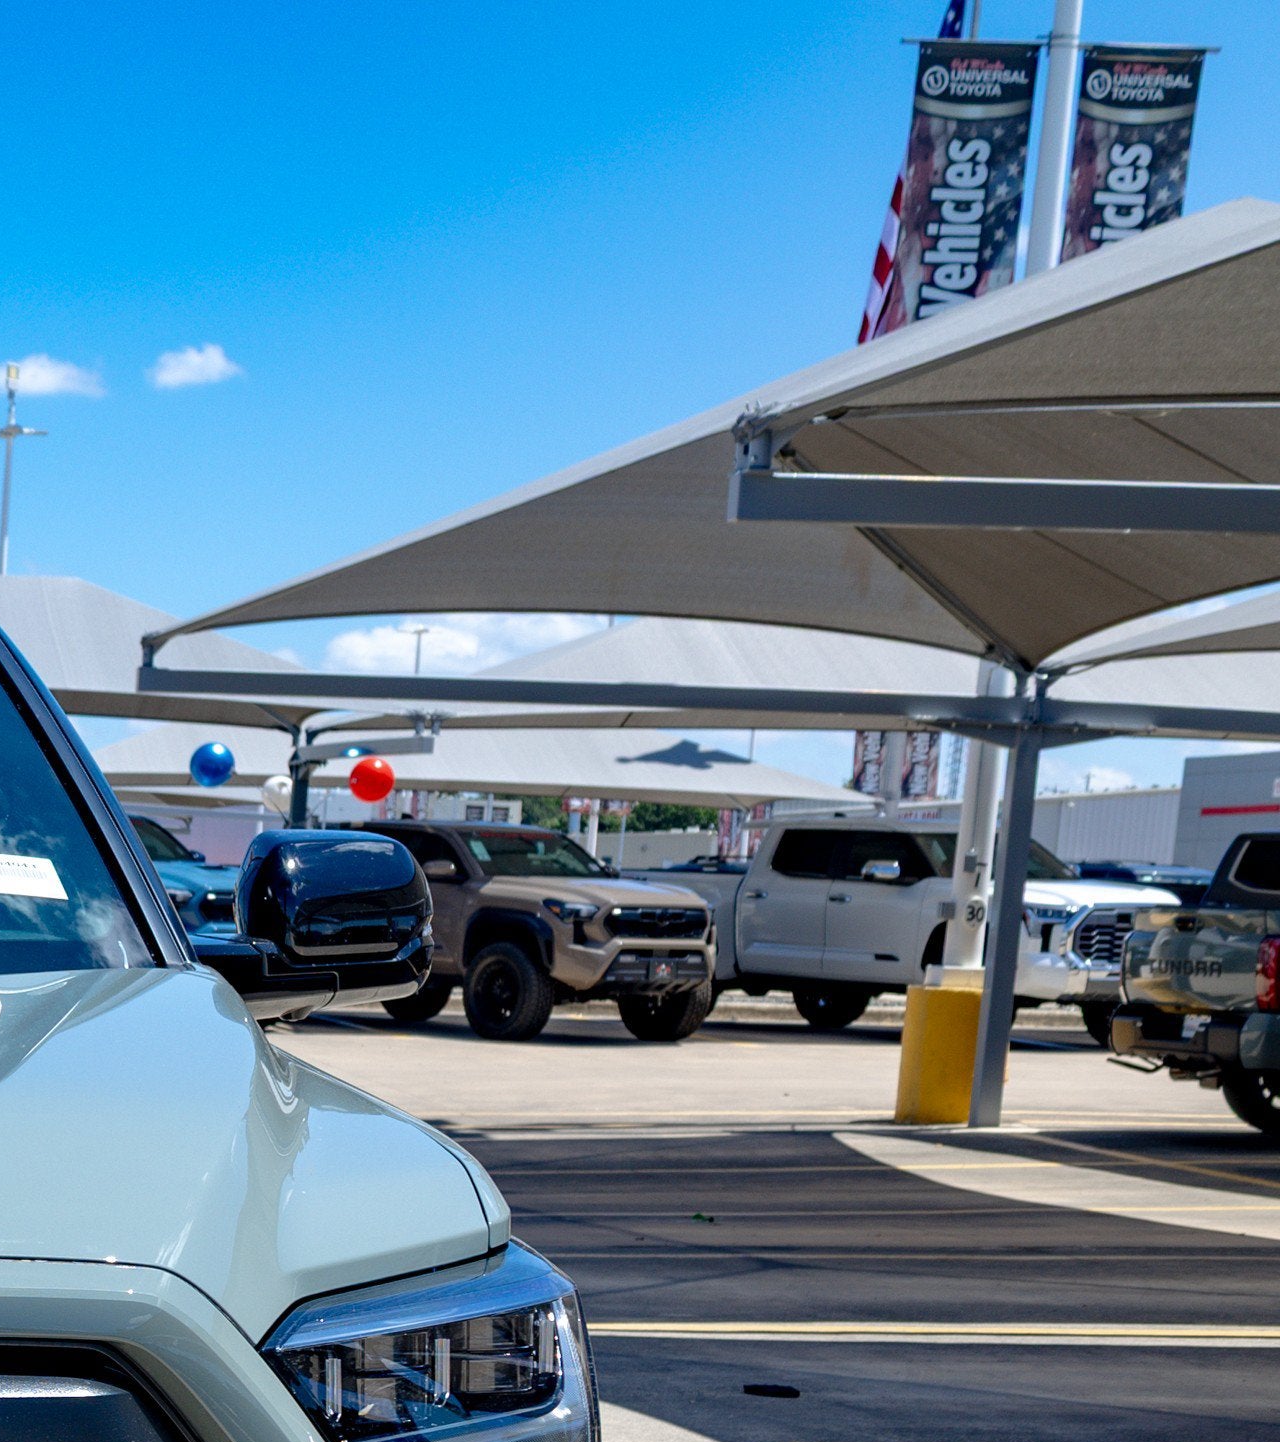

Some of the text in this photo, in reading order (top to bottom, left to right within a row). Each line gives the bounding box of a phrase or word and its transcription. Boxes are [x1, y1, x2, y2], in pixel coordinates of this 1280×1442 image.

[950, 69, 1029, 85] UNIVERSAL
[1113, 74, 1193, 89] UNIVERSAL
[949, 82, 1002, 97] TOYOTA
[1112, 87, 1164, 101] TOYOTA
[1090, 143, 1153, 248] icles
[919, 138, 991, 319] Vehicles
[966, 904, 985, 922] 30
[1148, 958, 1222, 978] TUNDRA
